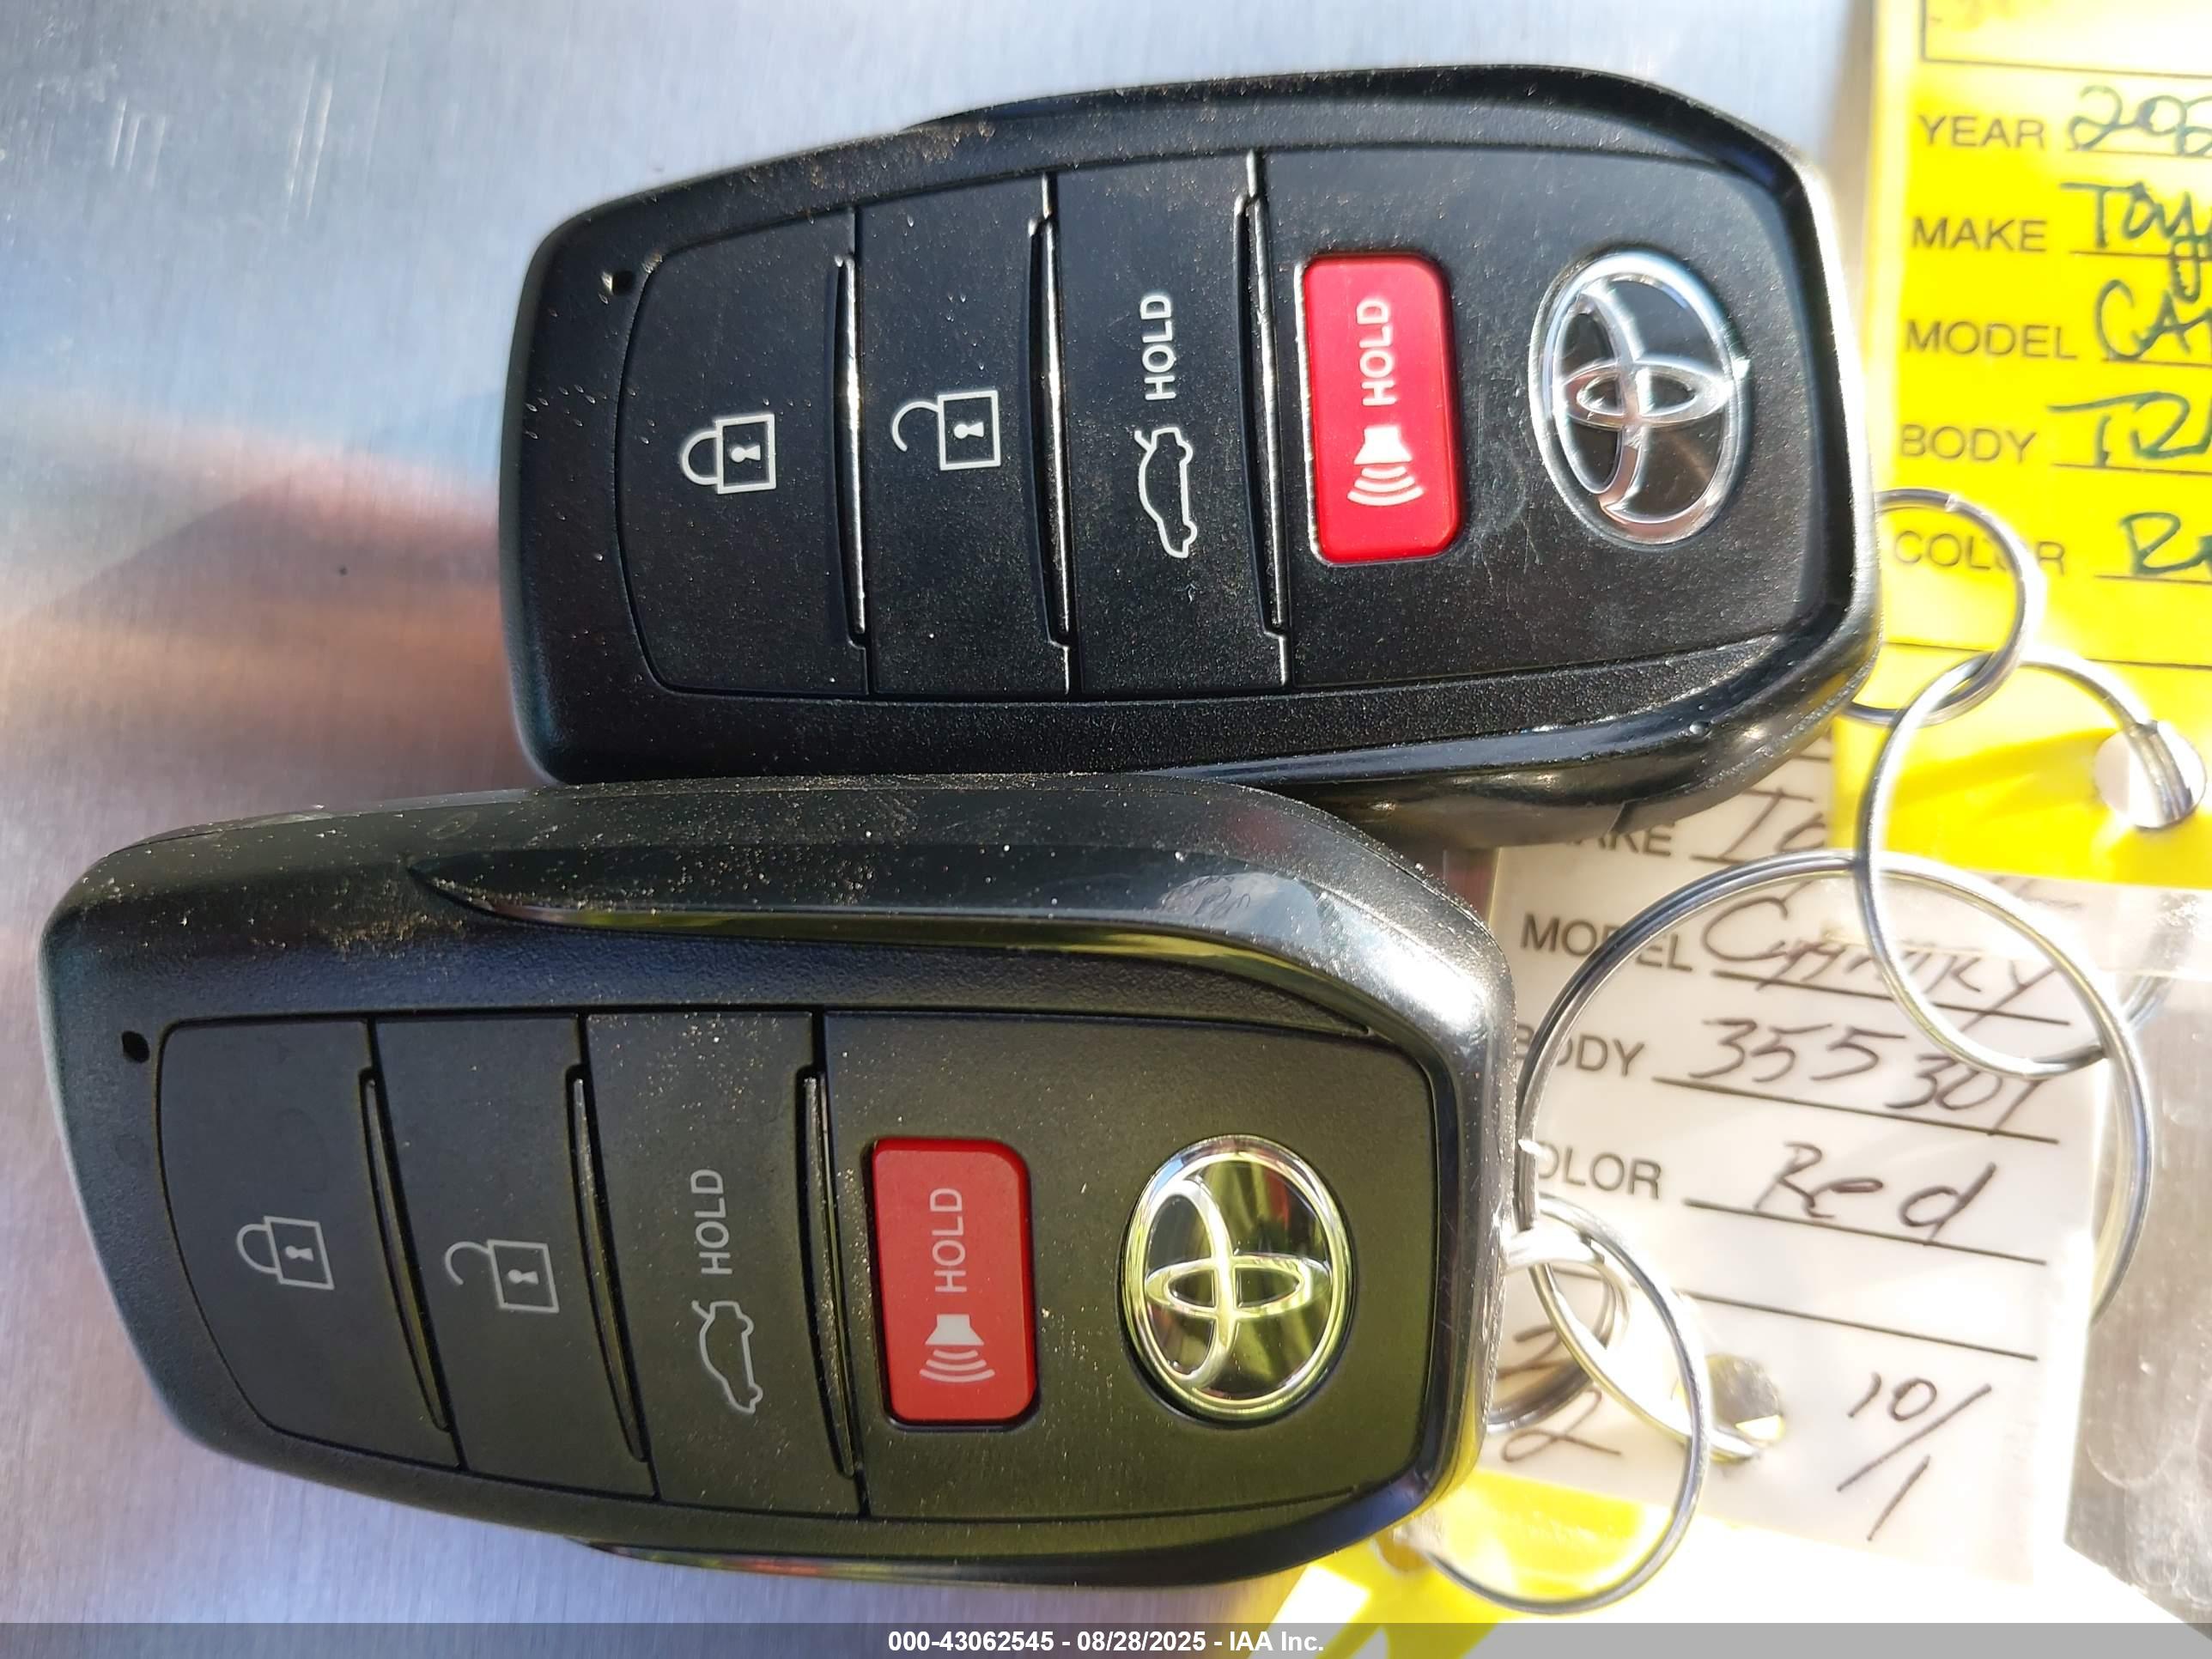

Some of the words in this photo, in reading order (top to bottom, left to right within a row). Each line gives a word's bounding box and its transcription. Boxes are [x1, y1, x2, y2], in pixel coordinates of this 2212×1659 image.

[1917, 114, 2045, 149] YEAR
[1911, 216, 2048, 252] MAKE
[1139, 295, 1176, 401] HOLD
[1356, 299, 1397, 406] HOLD
[1906, 319, 2078, 361] MODEL
[2094, 278, 2212, 362] CA
[1899, 424, 2038, 464] BODY
[690, 1169, 733, 1275] HOLD
[1753, 1141, 1996, 1243] Red
[929, 1188, 968, 1292] HOLD
